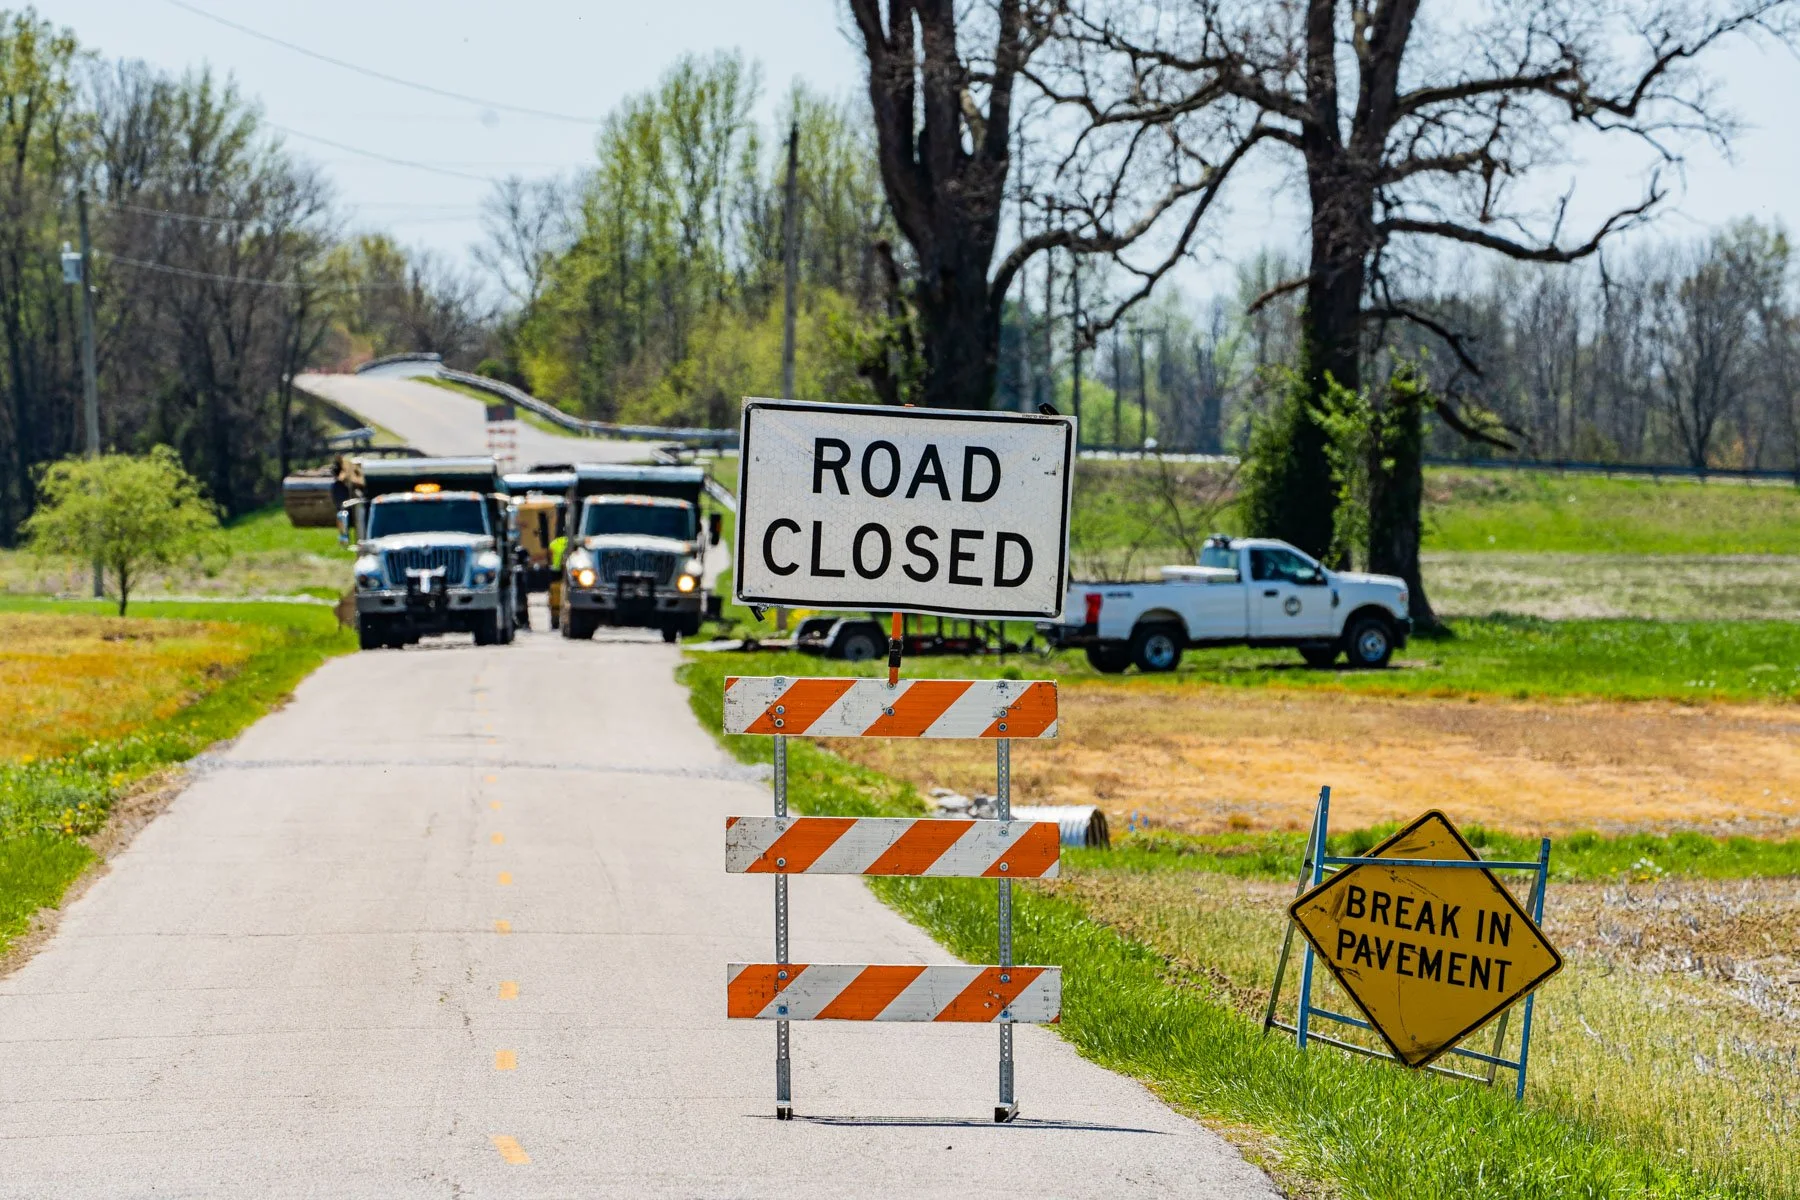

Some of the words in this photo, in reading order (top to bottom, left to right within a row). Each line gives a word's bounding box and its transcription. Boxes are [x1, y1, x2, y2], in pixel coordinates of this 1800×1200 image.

[812, 437, 1001, 502] ROAD
[762, 517, 1034, 588] CLOSED
[1345, 884, 1462, 939] BREAK
[1475, 909, 1512, 948] IN
[1336, 928, 1513, 993] PAVEMENT
